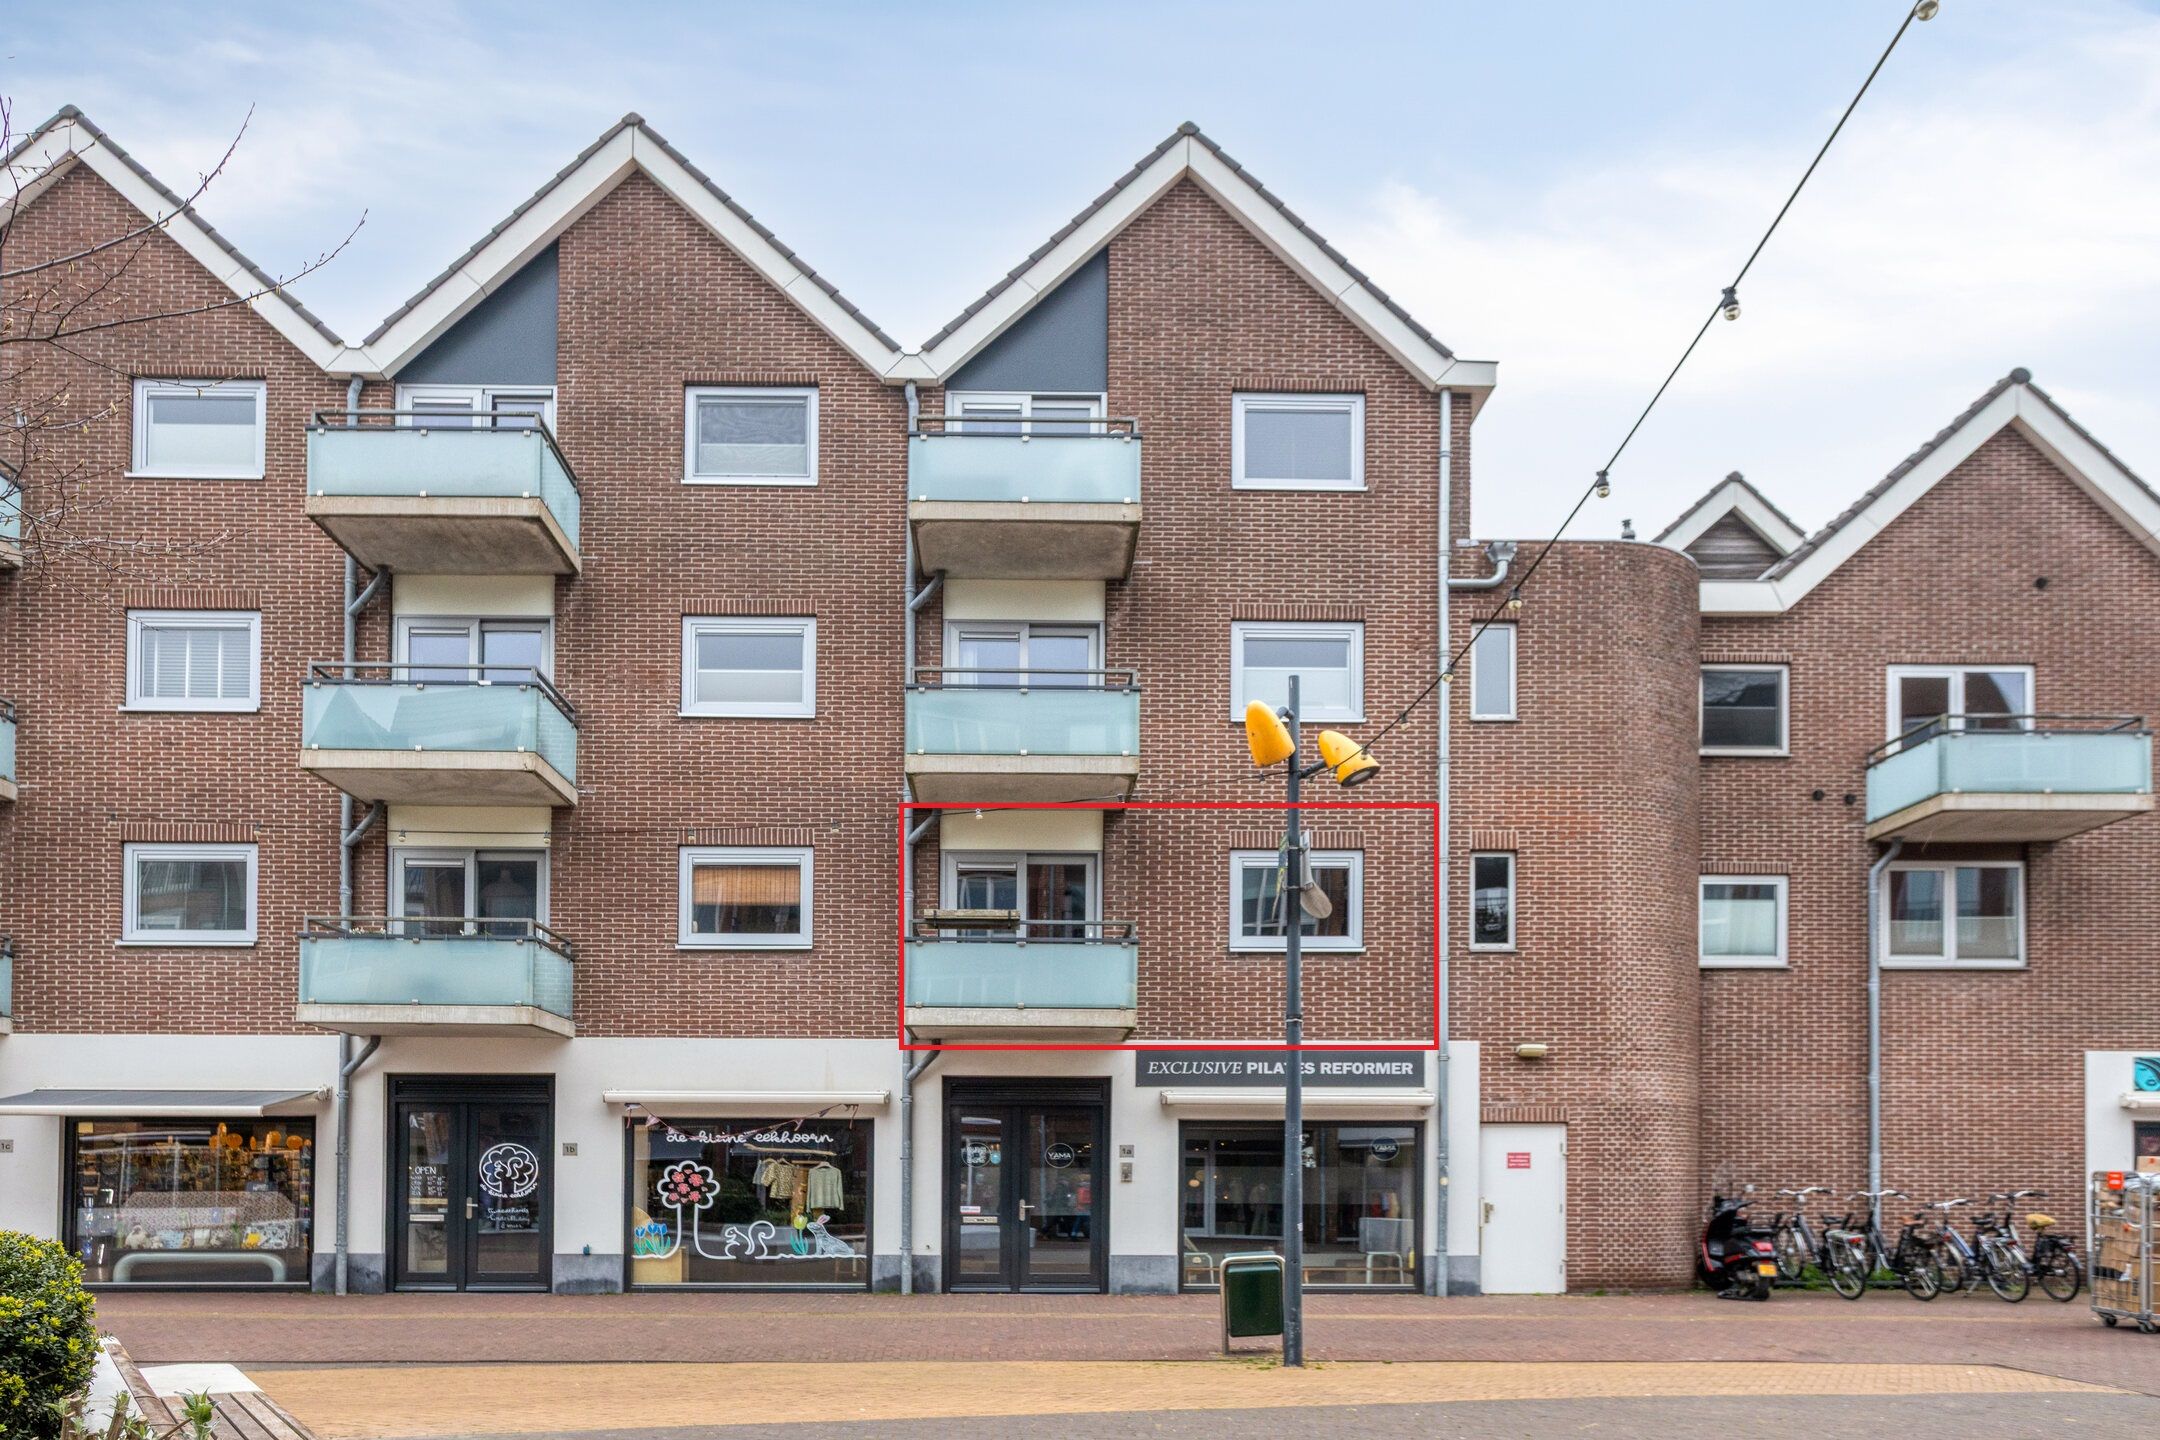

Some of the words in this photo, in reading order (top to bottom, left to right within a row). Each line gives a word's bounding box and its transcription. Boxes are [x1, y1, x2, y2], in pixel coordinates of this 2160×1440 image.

[1147, 1061, 1242, 1075] EXCLUSIVE
[1246, 1062, 1315, 1075] PILAS
[1320, 1062, 1414, 1075] REFORMER
[666, 1131, 688, 1143] de
[698, 1130, 746, 1144] kleine
[753, 1130, 834, 1144] eekhoorn
[566, 1145, 575, 1153] 1b
[1122, 1147, 1132, 1155] 1a
[1374, 1144, 1397, 1153] YAMA
[1047, 1151, 1072, 1160] YAMA
[414, 1165, 437, 1175] OPEN
